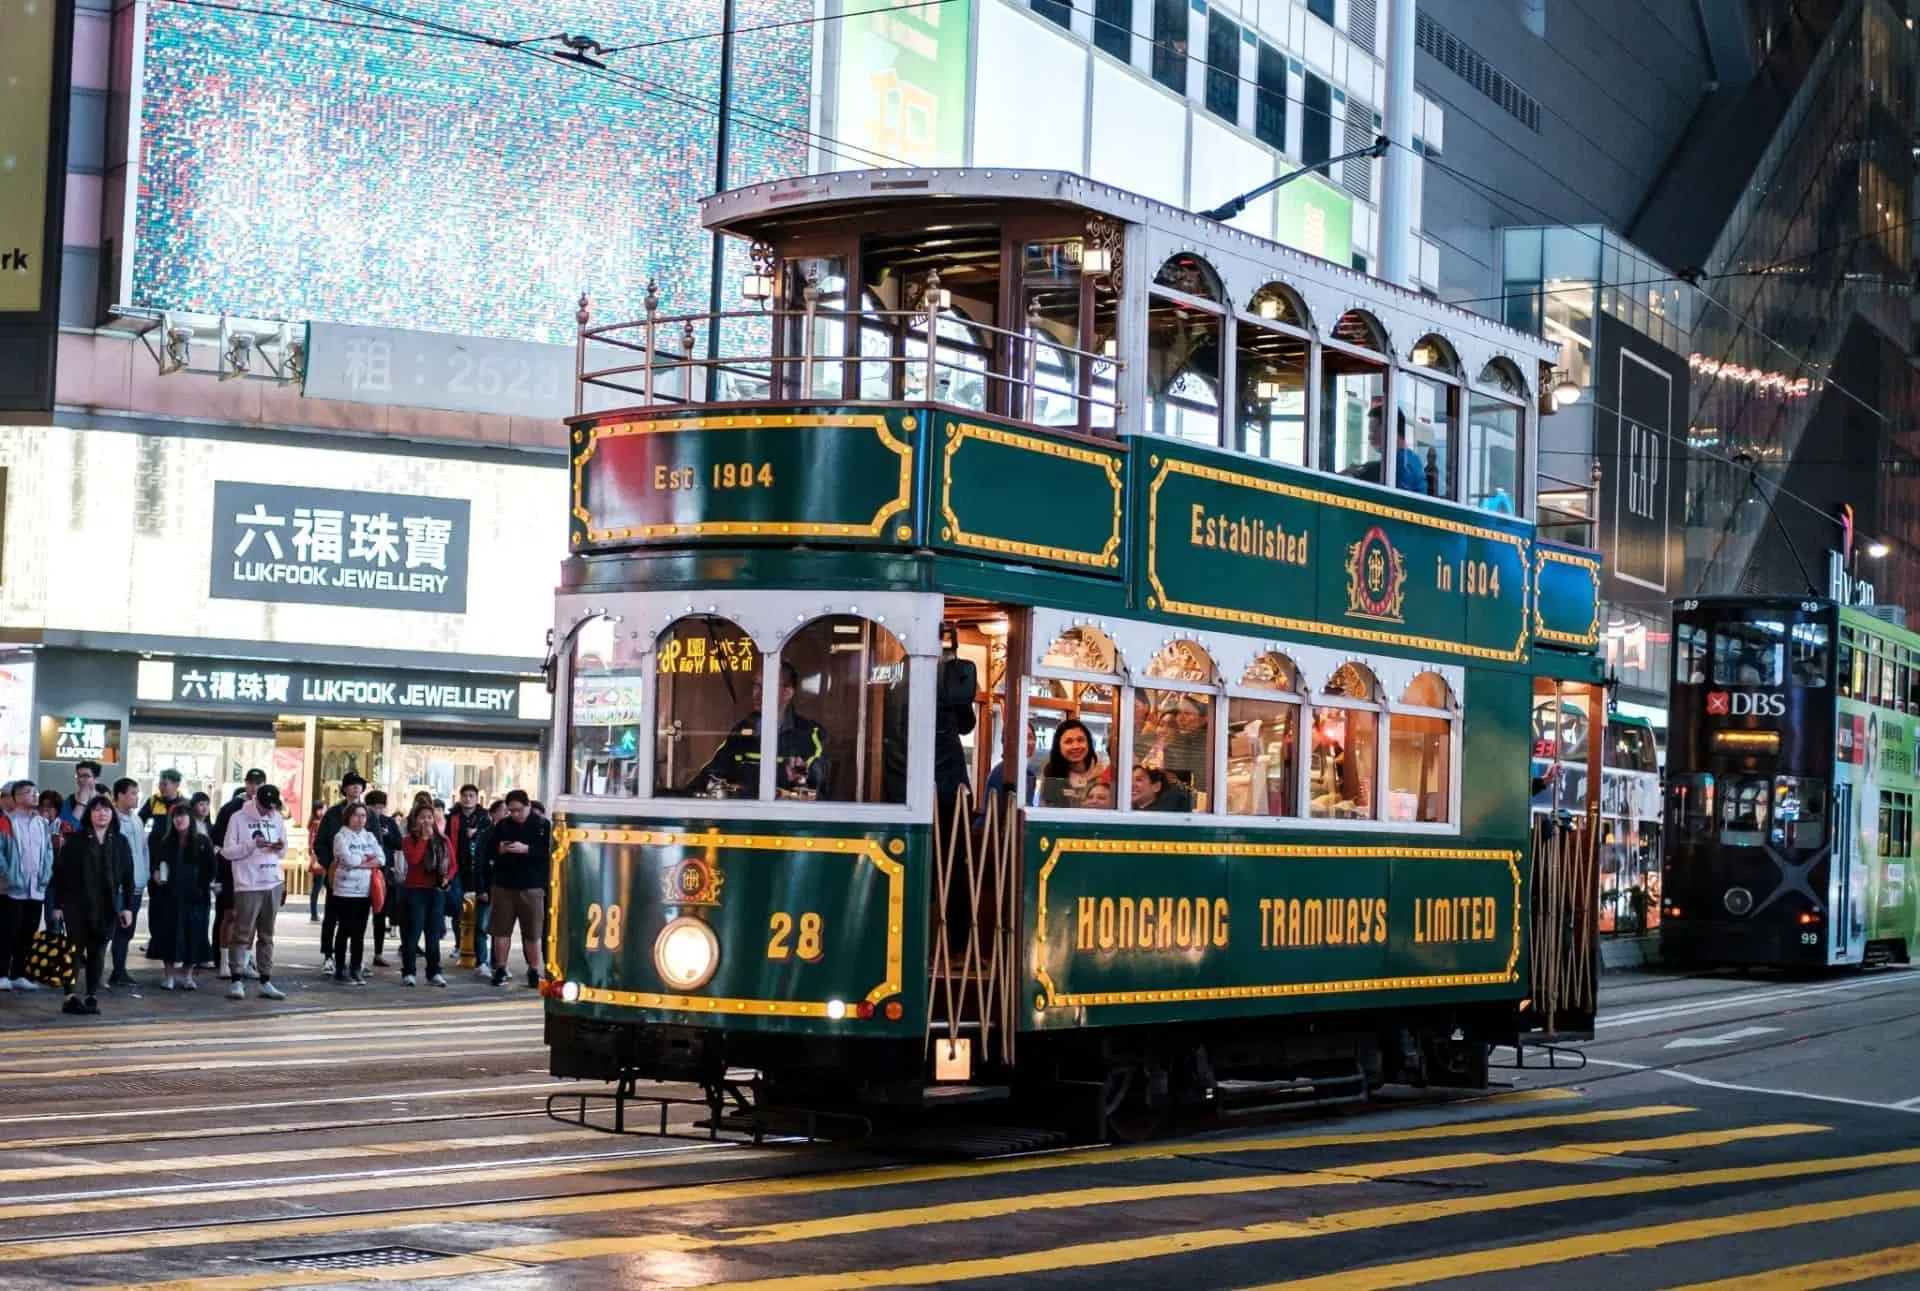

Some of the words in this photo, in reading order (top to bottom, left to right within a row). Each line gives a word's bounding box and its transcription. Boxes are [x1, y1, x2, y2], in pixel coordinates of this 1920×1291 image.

[654, 465, 697, 491] Est.
[713, 462, 773, 489] 1904
[1629, 423, 1659, 520] GAP
[234, 504, 452, 571] 六福珠寶
[1190, 503, 1309, 567] Established
[1436, 556, 1452, 592] in
[1459, 558, 1501, 598] 1904
[233, 560, 327, 586] LUKFOOK
[332, 568, 448, 593] JEWELLERY
[181, 669, 290, 702] 六福珠寶
[303, 679, 395, 705] LUKFOOK
[399, 684, 515, 710] JEWELLERY
[1731, 692, 1786, 717] DBS
[586, 903, 623, 952] 28
[767, 911, 825, 964] 28
[1076, 895, 1230, 952] HONGKONG
[1259, 897, 1388, 948] TRAMWAYS
[1413, 895, 1497, 943] LIMITED
[1800, 933, 1818, 945] 99
